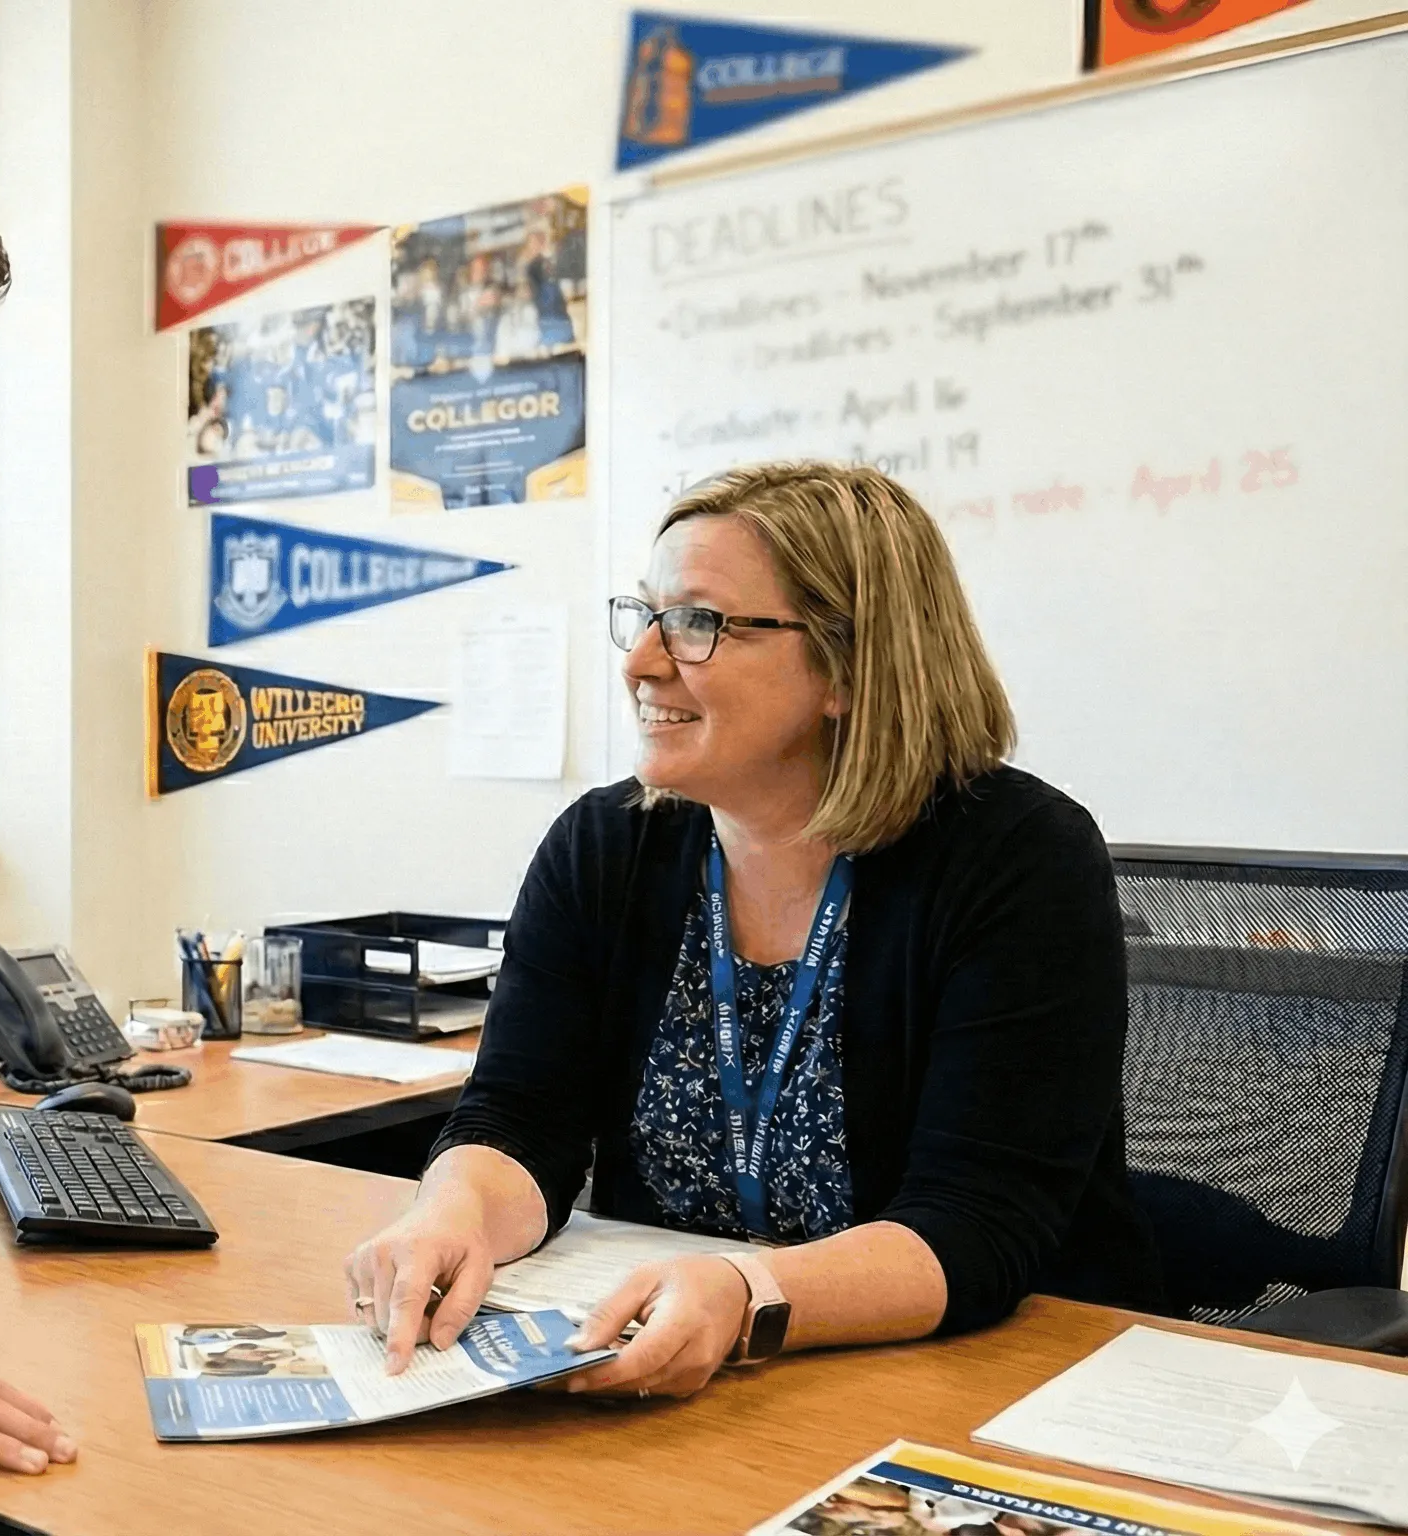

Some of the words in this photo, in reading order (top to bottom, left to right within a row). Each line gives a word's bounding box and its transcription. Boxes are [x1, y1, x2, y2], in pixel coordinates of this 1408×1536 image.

[651, 183, 910, 275] DEADLINES
[861, 250, 1026, 300] November
[934, 284, 1121, 343] September
[407, 390, 560, 433] COLLEGOR
[842, 380, 920, 429] April
[947, 430, 980, 467] 19
[1129, 462, 1223, 519] April
[1239, 446, 1301, 494] 25
[291, 543, 421, 609] COLLEGE
[253, 712, 366, 749] UNIVERSITY
